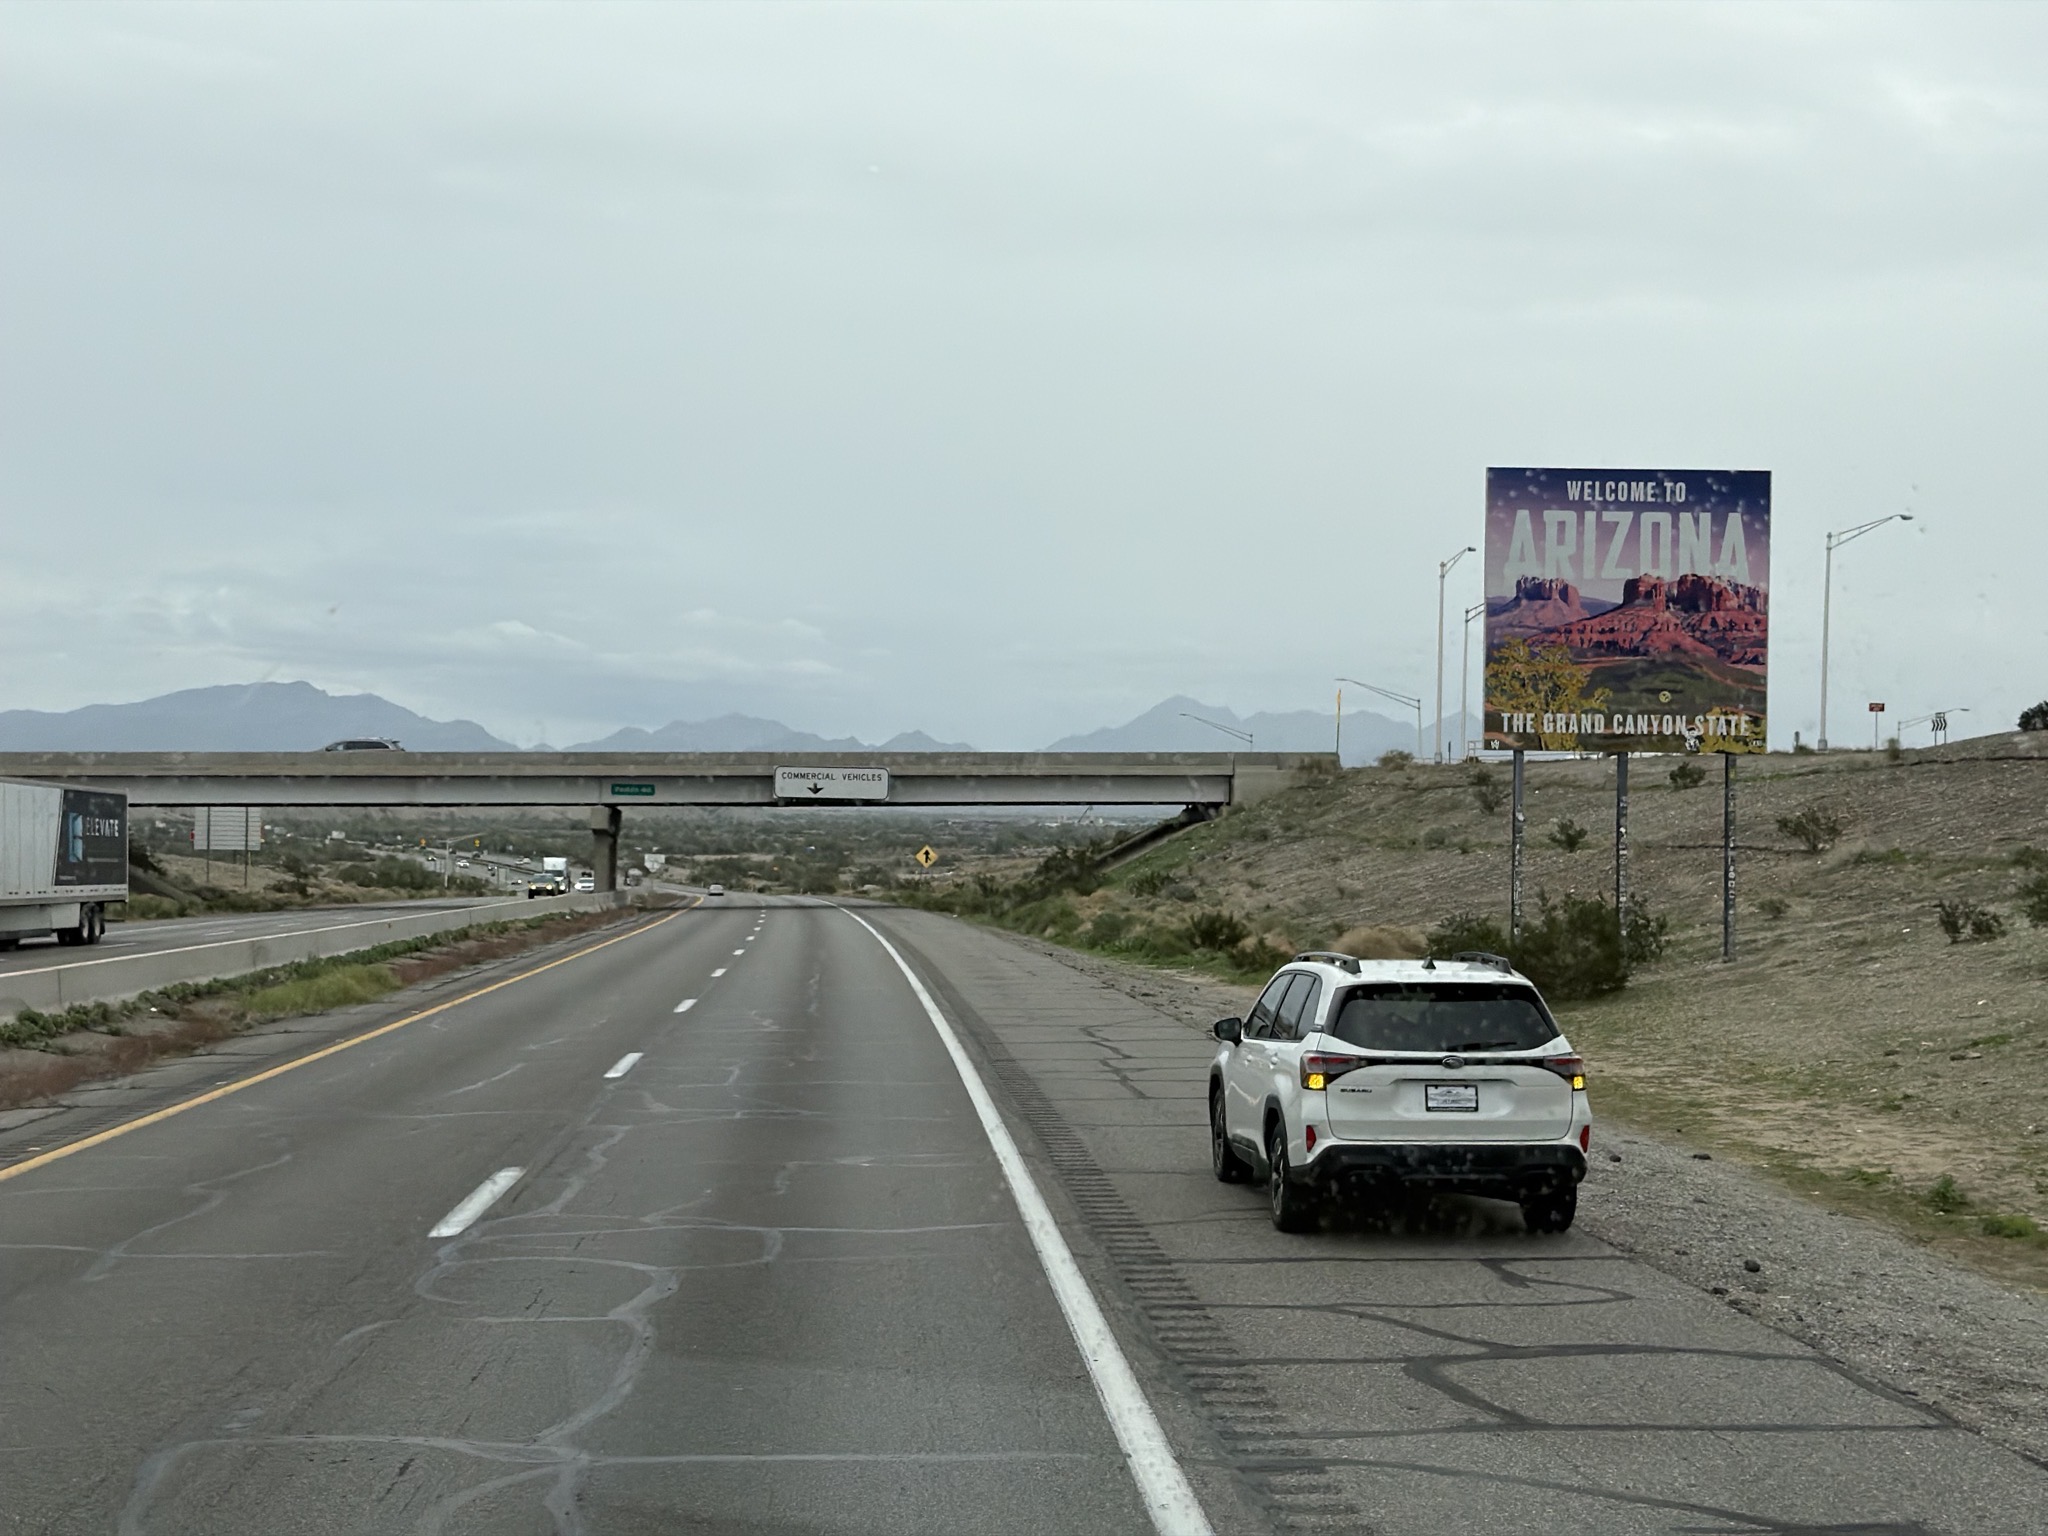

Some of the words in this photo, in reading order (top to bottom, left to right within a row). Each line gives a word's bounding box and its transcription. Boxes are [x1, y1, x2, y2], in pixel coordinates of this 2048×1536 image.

[1567, 480, 1655, 502] WELCOME
[1664, 482, 1686, 502] TO
[1503, 509, 1750, 583] ARIZONA
[1501, 713, 1535, 733] THE
[1543, 713, 1605, 735] GRAND
[1613, 714, 1687, 736] CANYON
[1694, 714, 1750, 737] STATE
[781, 771, 836, 781] COMMERCIAL
[841, 773, 882, 782] VEHICLES
[86, 817, 119, 837] ELEVATE
